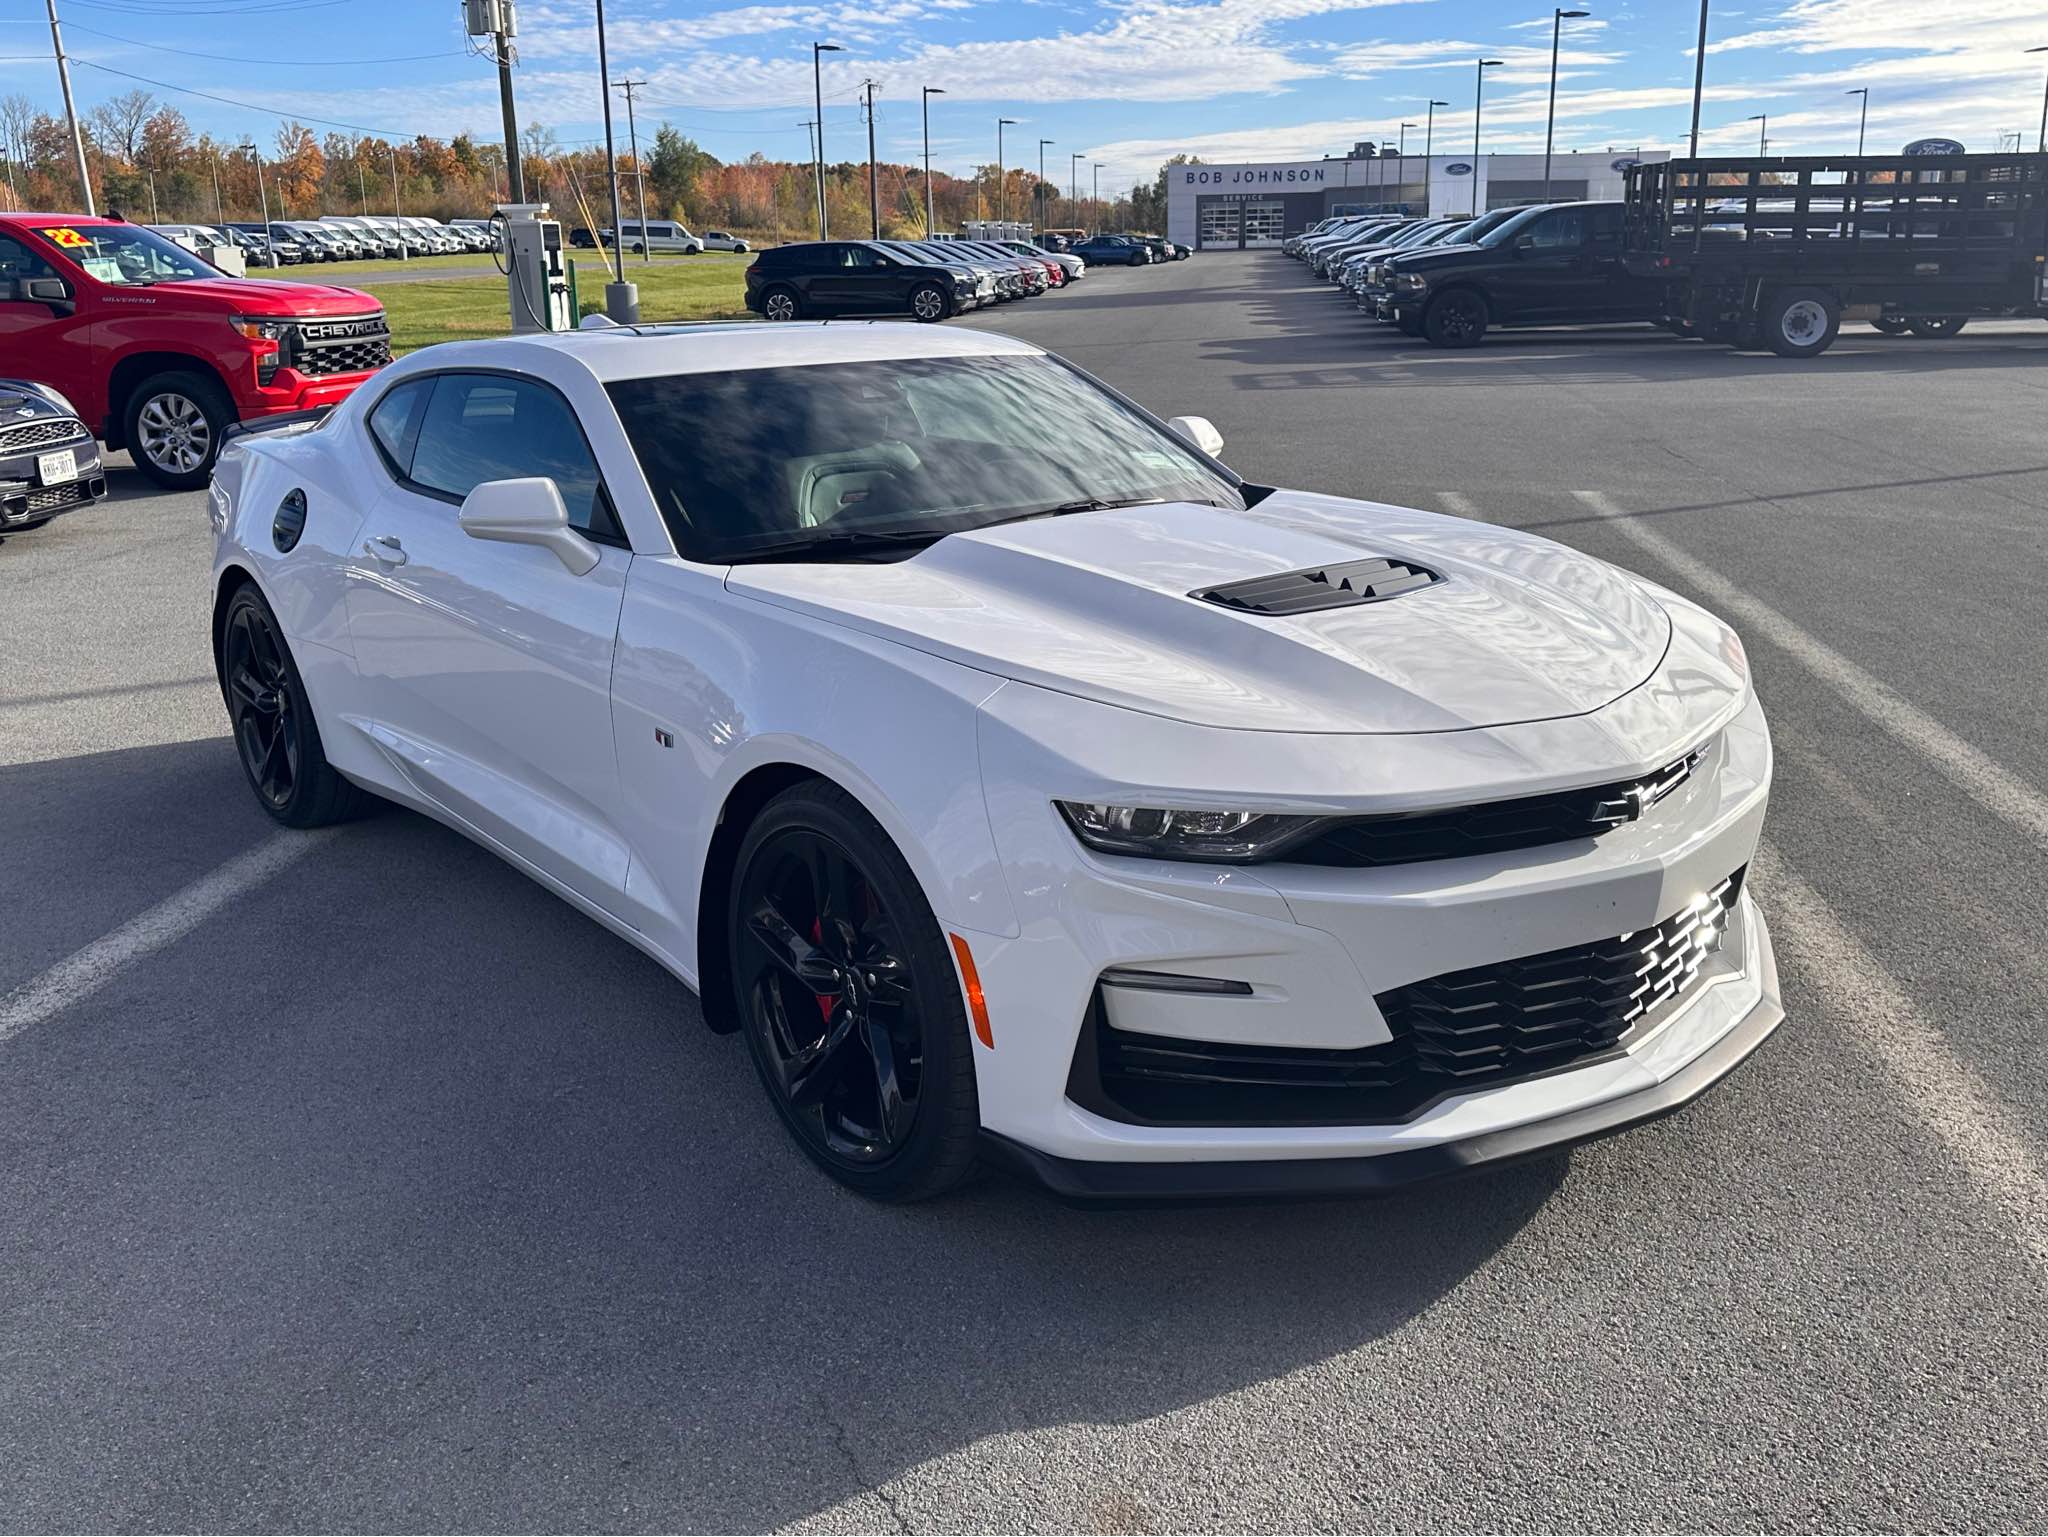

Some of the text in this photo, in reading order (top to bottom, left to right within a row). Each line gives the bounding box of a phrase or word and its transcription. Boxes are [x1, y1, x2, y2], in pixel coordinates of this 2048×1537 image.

[1917, 143, 1955, 156] Ford
[1186, 169, 1325, 184] BOB JOHNSON
[44, 229, 94, 248] 22
